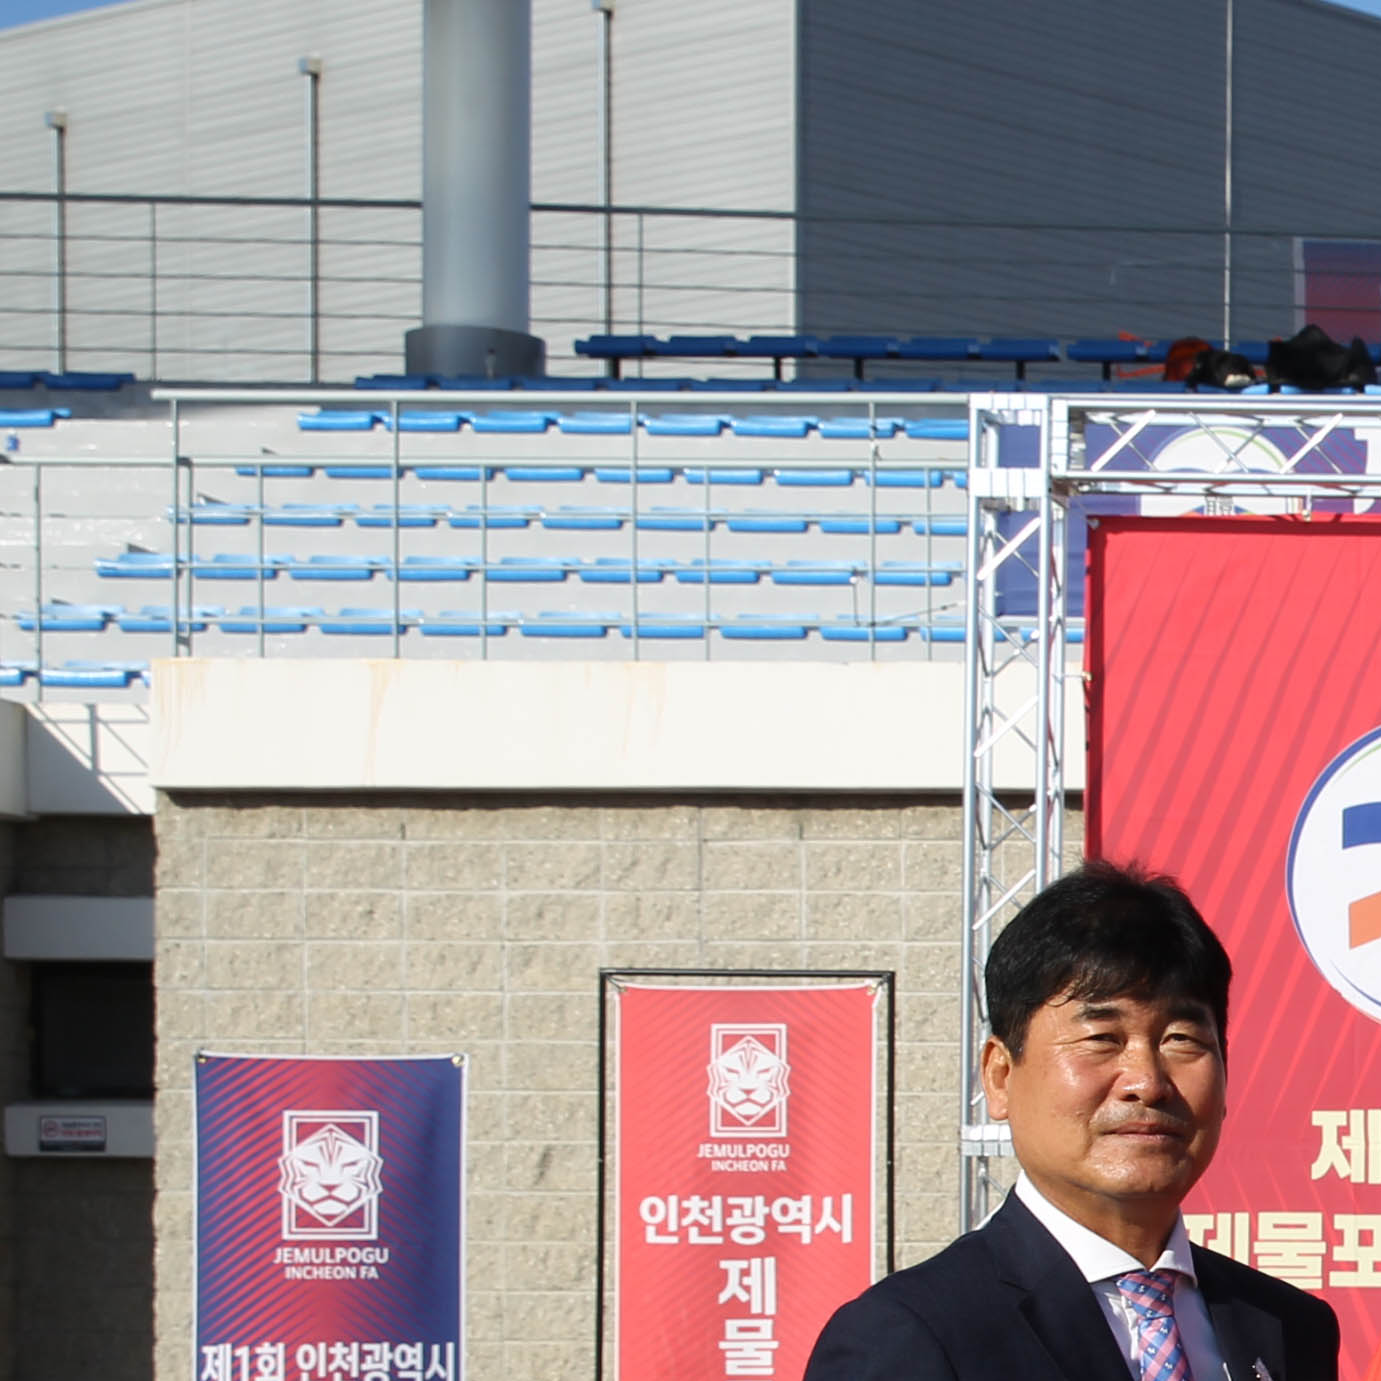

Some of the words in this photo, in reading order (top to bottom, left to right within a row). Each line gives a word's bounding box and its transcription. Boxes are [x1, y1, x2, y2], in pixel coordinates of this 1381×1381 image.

[698, 1144, 790, 1158] JEMULPOGU
[711, 1160, 768, 1172] INCHEON
[771, 1160, 787, 1172] FA
[639, 1194, 853, 1245] 인천광역시
[274, 1247, 389, 1264] JEMULPOGU
[285, 1266, 356, 1280] INCHEON
[360, 1266, 379, 1280] FA
